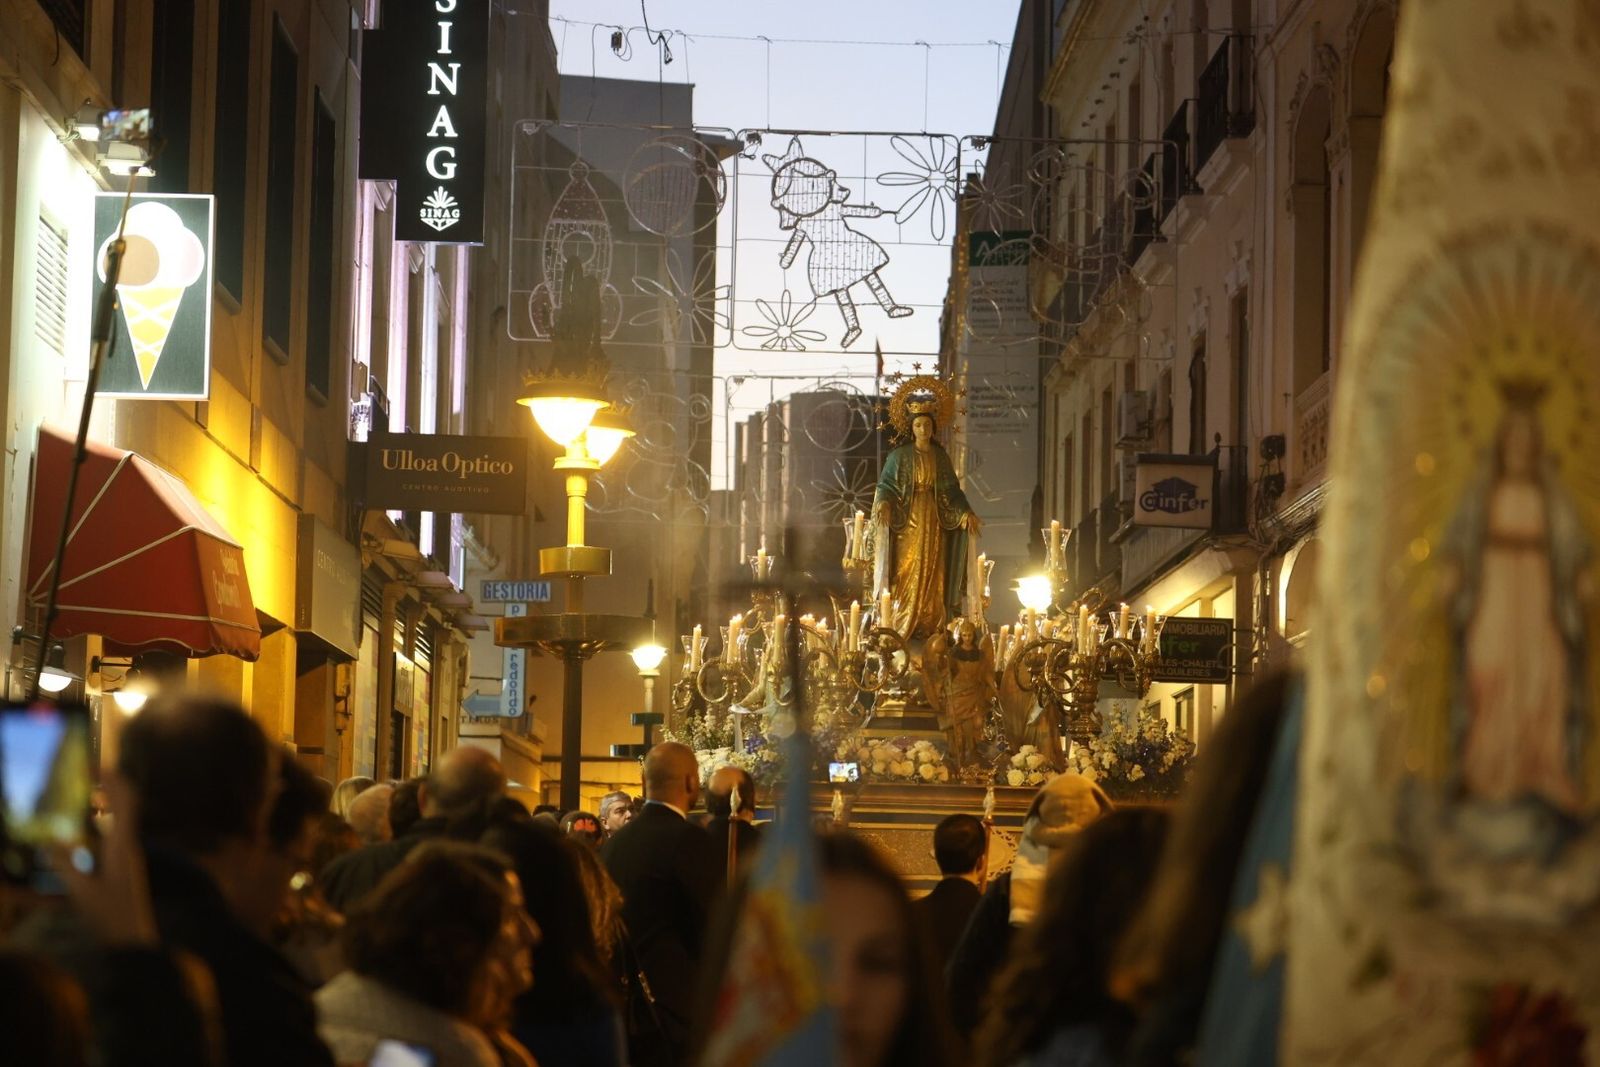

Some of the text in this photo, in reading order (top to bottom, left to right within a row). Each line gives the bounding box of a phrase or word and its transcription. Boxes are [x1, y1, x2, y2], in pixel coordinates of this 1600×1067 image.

[420, 209, 460, 218] SINAG
[382, 449, 514, 479] Ulloa Optico
[402, 483, 489, 494] CENTRO AUDITIVO
[483, 582, 549, 600] GESTORIA
